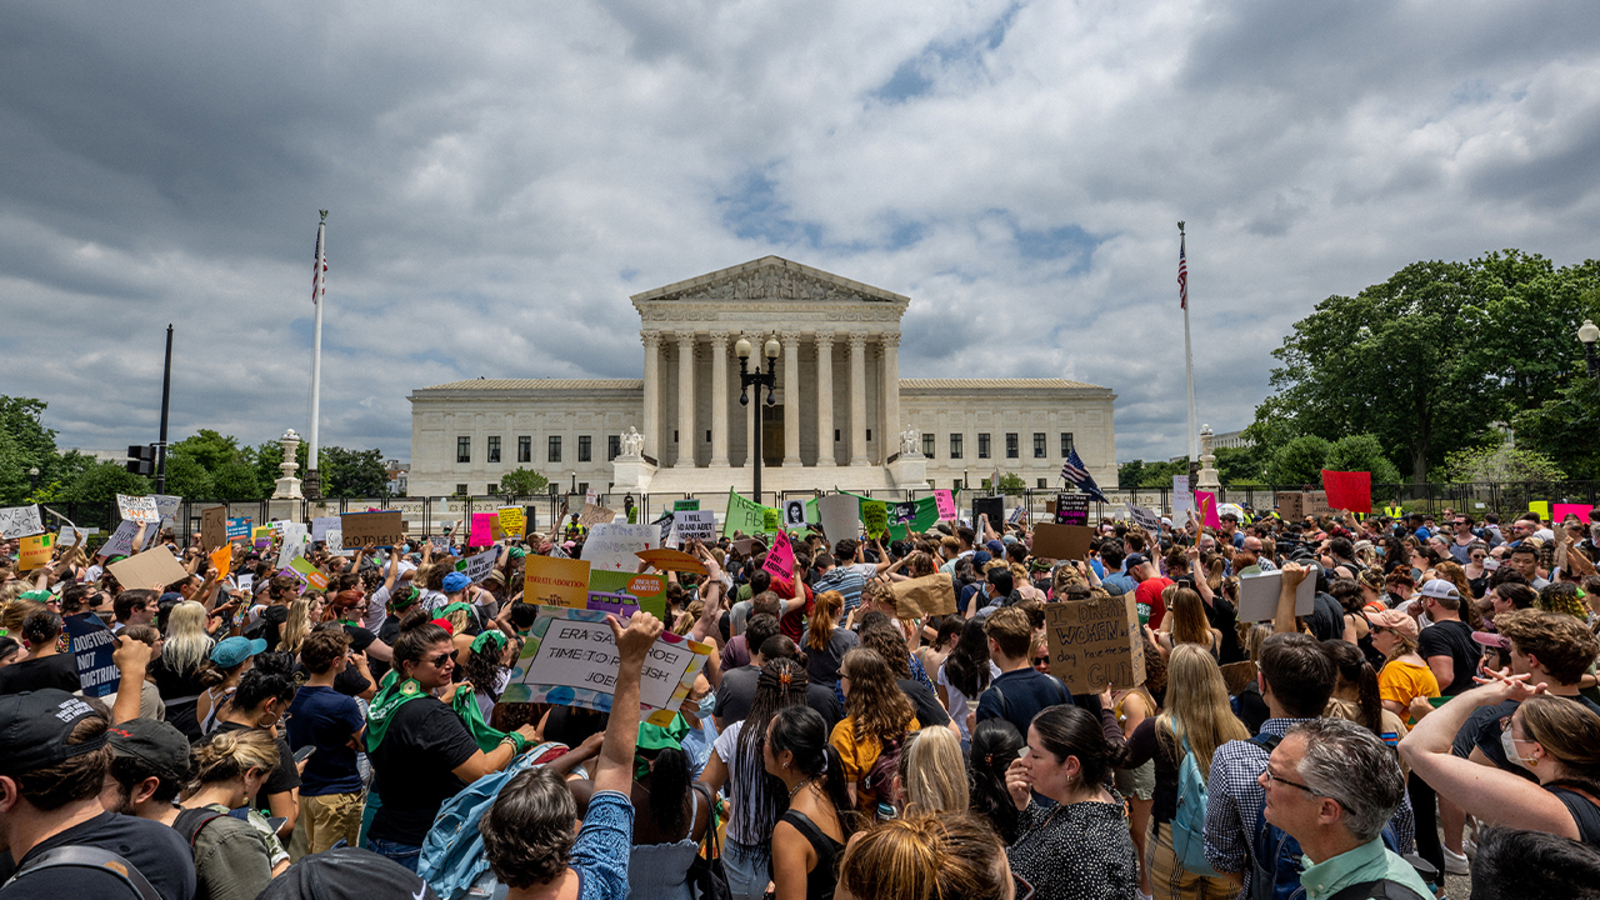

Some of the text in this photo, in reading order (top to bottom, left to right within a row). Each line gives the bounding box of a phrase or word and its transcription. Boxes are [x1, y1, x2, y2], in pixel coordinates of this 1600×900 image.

[0, 508, 21, 520] WE
[689, 514, 701, 522] WILL
[3, 529, 21, 538] GO
[344, 536, 361, 547] GO
[468, 567, 480, 578] AND
[553, 578, 586, 589] ABORTION
[631, 584, 661, 592] ABORTION
[1047, 605, 1067, 626] I
[559, 628, 588, 640] ERA
[1056, 621, 1119, 646] WOMEN
[73, 629, 115, 652] DOCTORS
[76, 651, 96, 671] NOT
[549, 647, 582, 660] TIME
[588, 650, 608, 663] TO
[1057, 650, 1076, 667] day
[1083, 648, 1103, 659] have
[80, 664, 121, 689] DOCTRINE
[585, 672, 618, 687] JOE!
